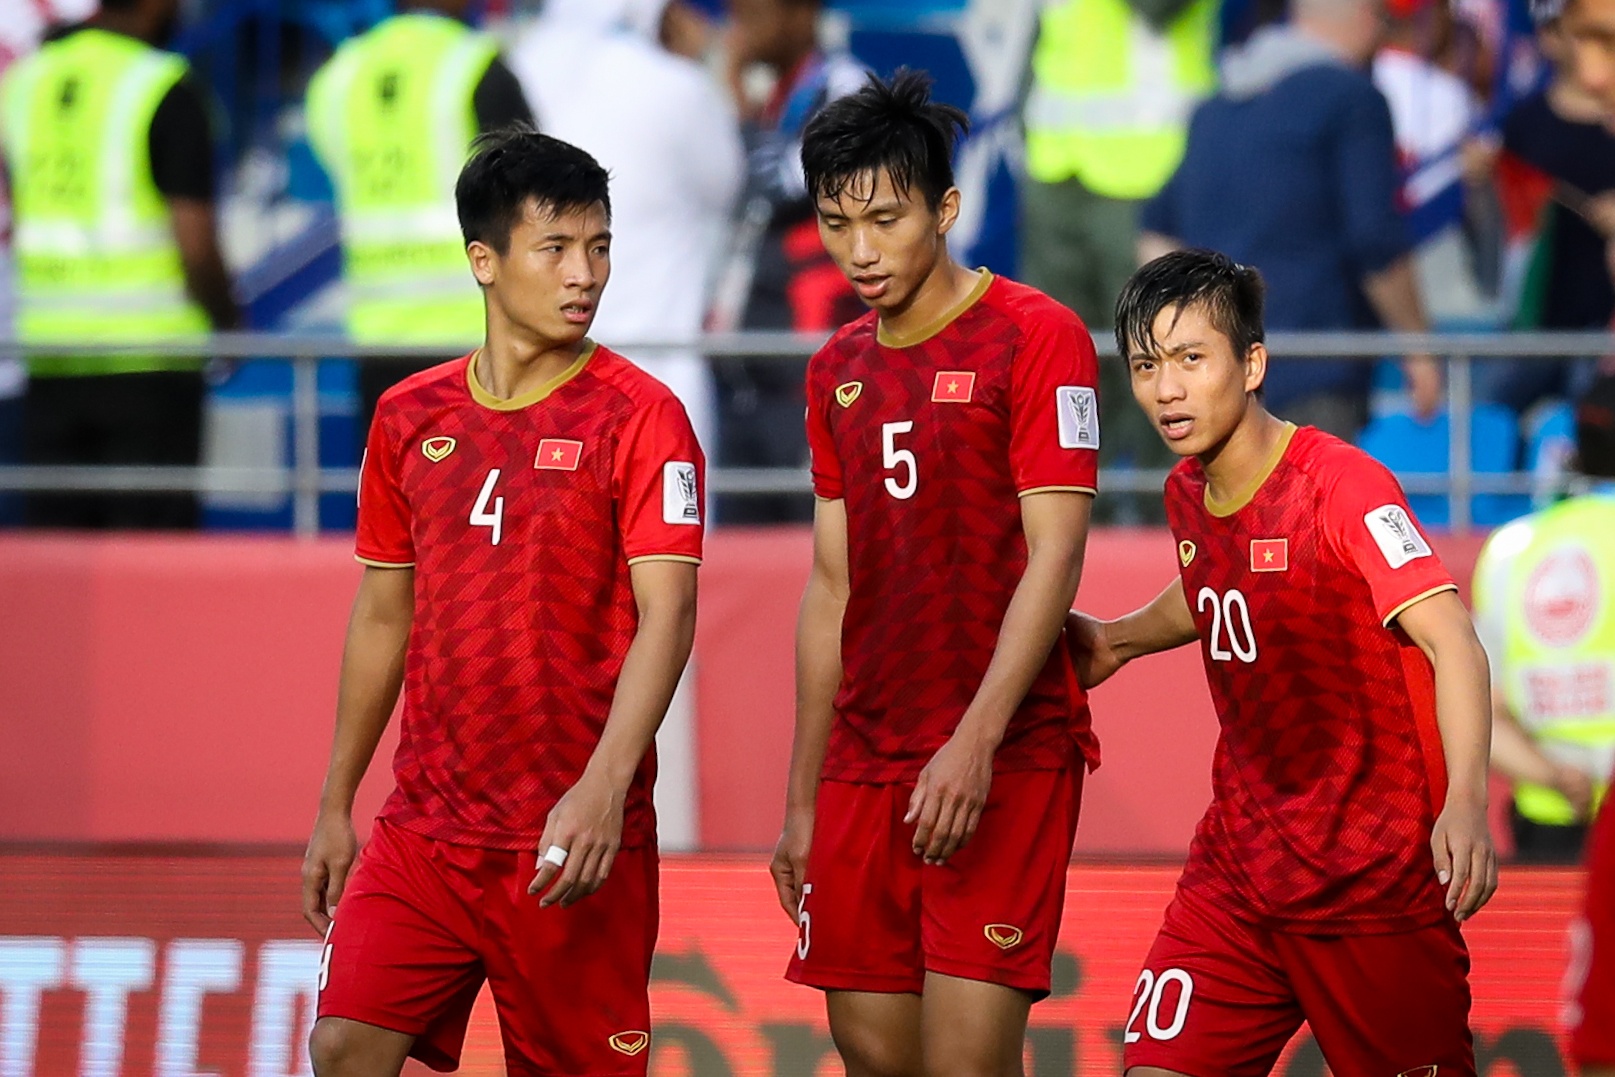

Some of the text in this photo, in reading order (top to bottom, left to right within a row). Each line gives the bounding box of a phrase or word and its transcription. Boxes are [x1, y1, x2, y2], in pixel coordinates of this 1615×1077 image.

[881, 420, 918, 500] 5
[469, 468, 504, 546] 4
[1197, 586, 1258, 664] 20
[1123, 968, 1194, 1044] 20
